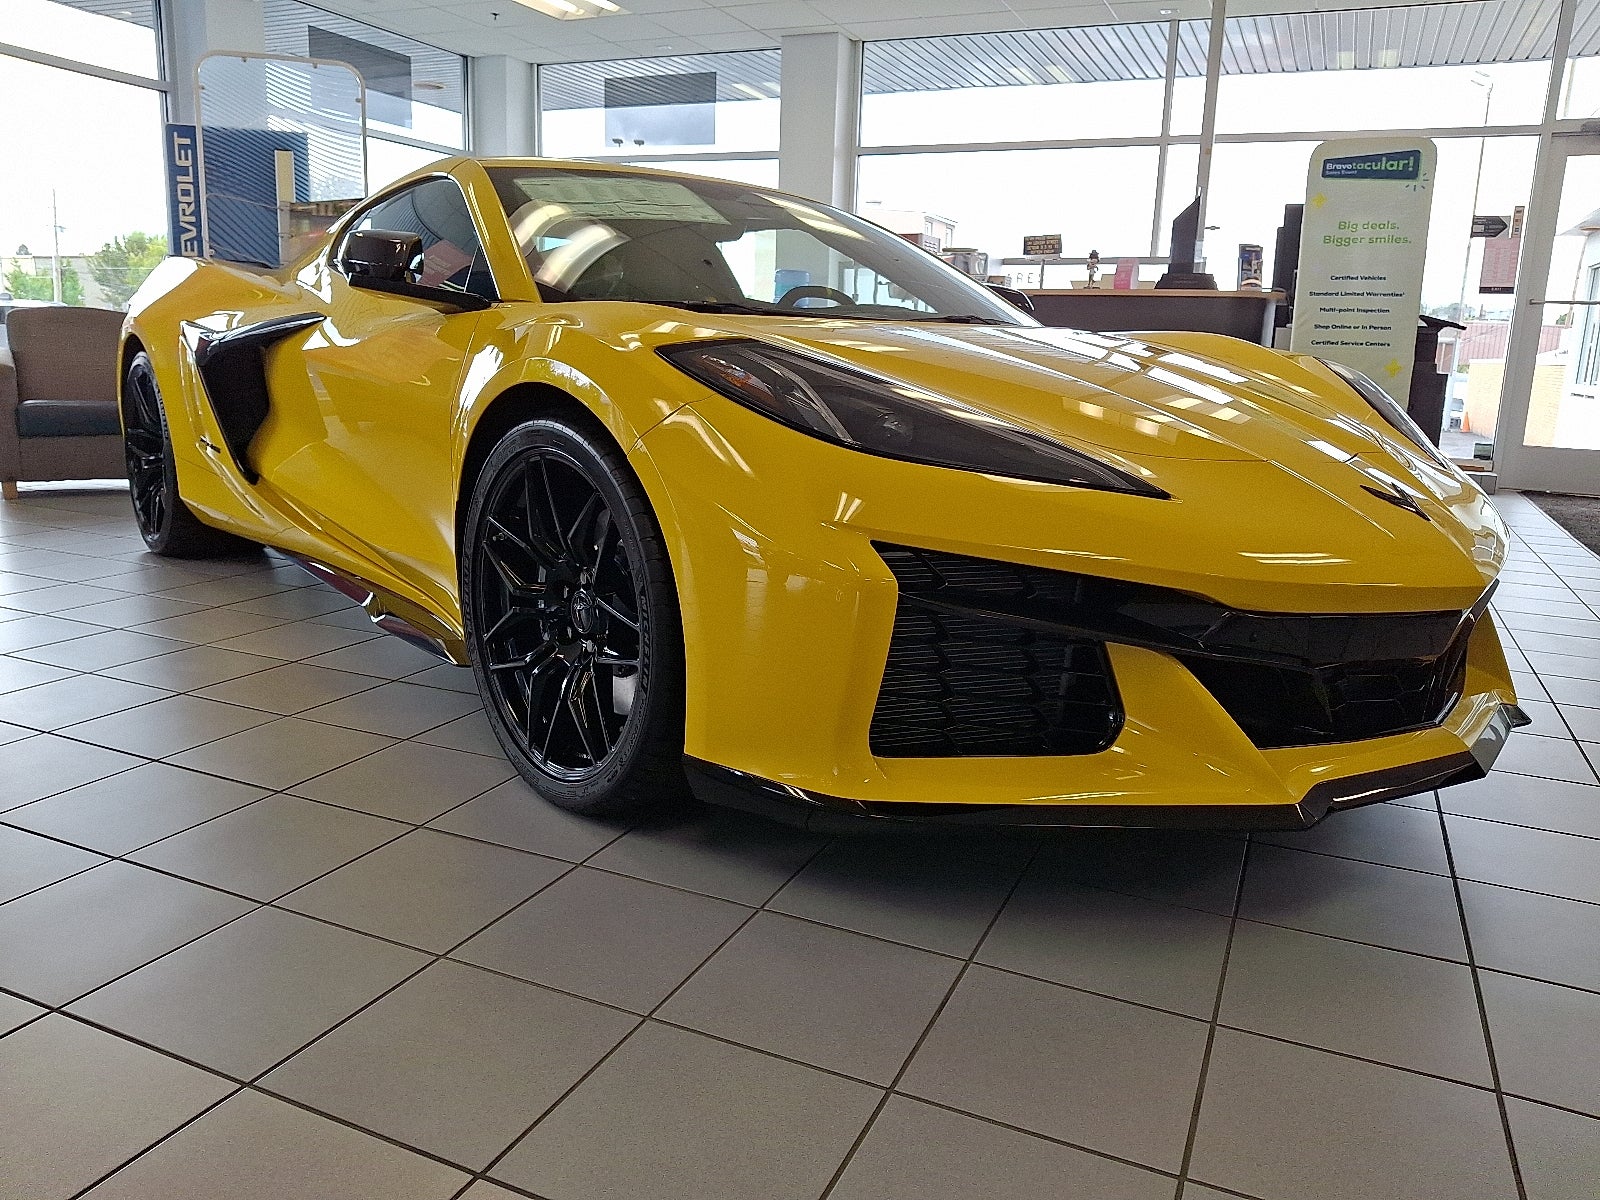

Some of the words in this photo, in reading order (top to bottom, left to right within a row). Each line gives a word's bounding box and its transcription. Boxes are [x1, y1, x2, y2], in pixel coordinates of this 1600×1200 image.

[1326, 156, 1414, 171] Bravotacular!
[1338, 221, 1359, 232] Big
[1362, 221, 1399, 230] deals.
[1323, 235, 1366, 247] Bigger
[1368, 235, 1412, 244] smiles.
